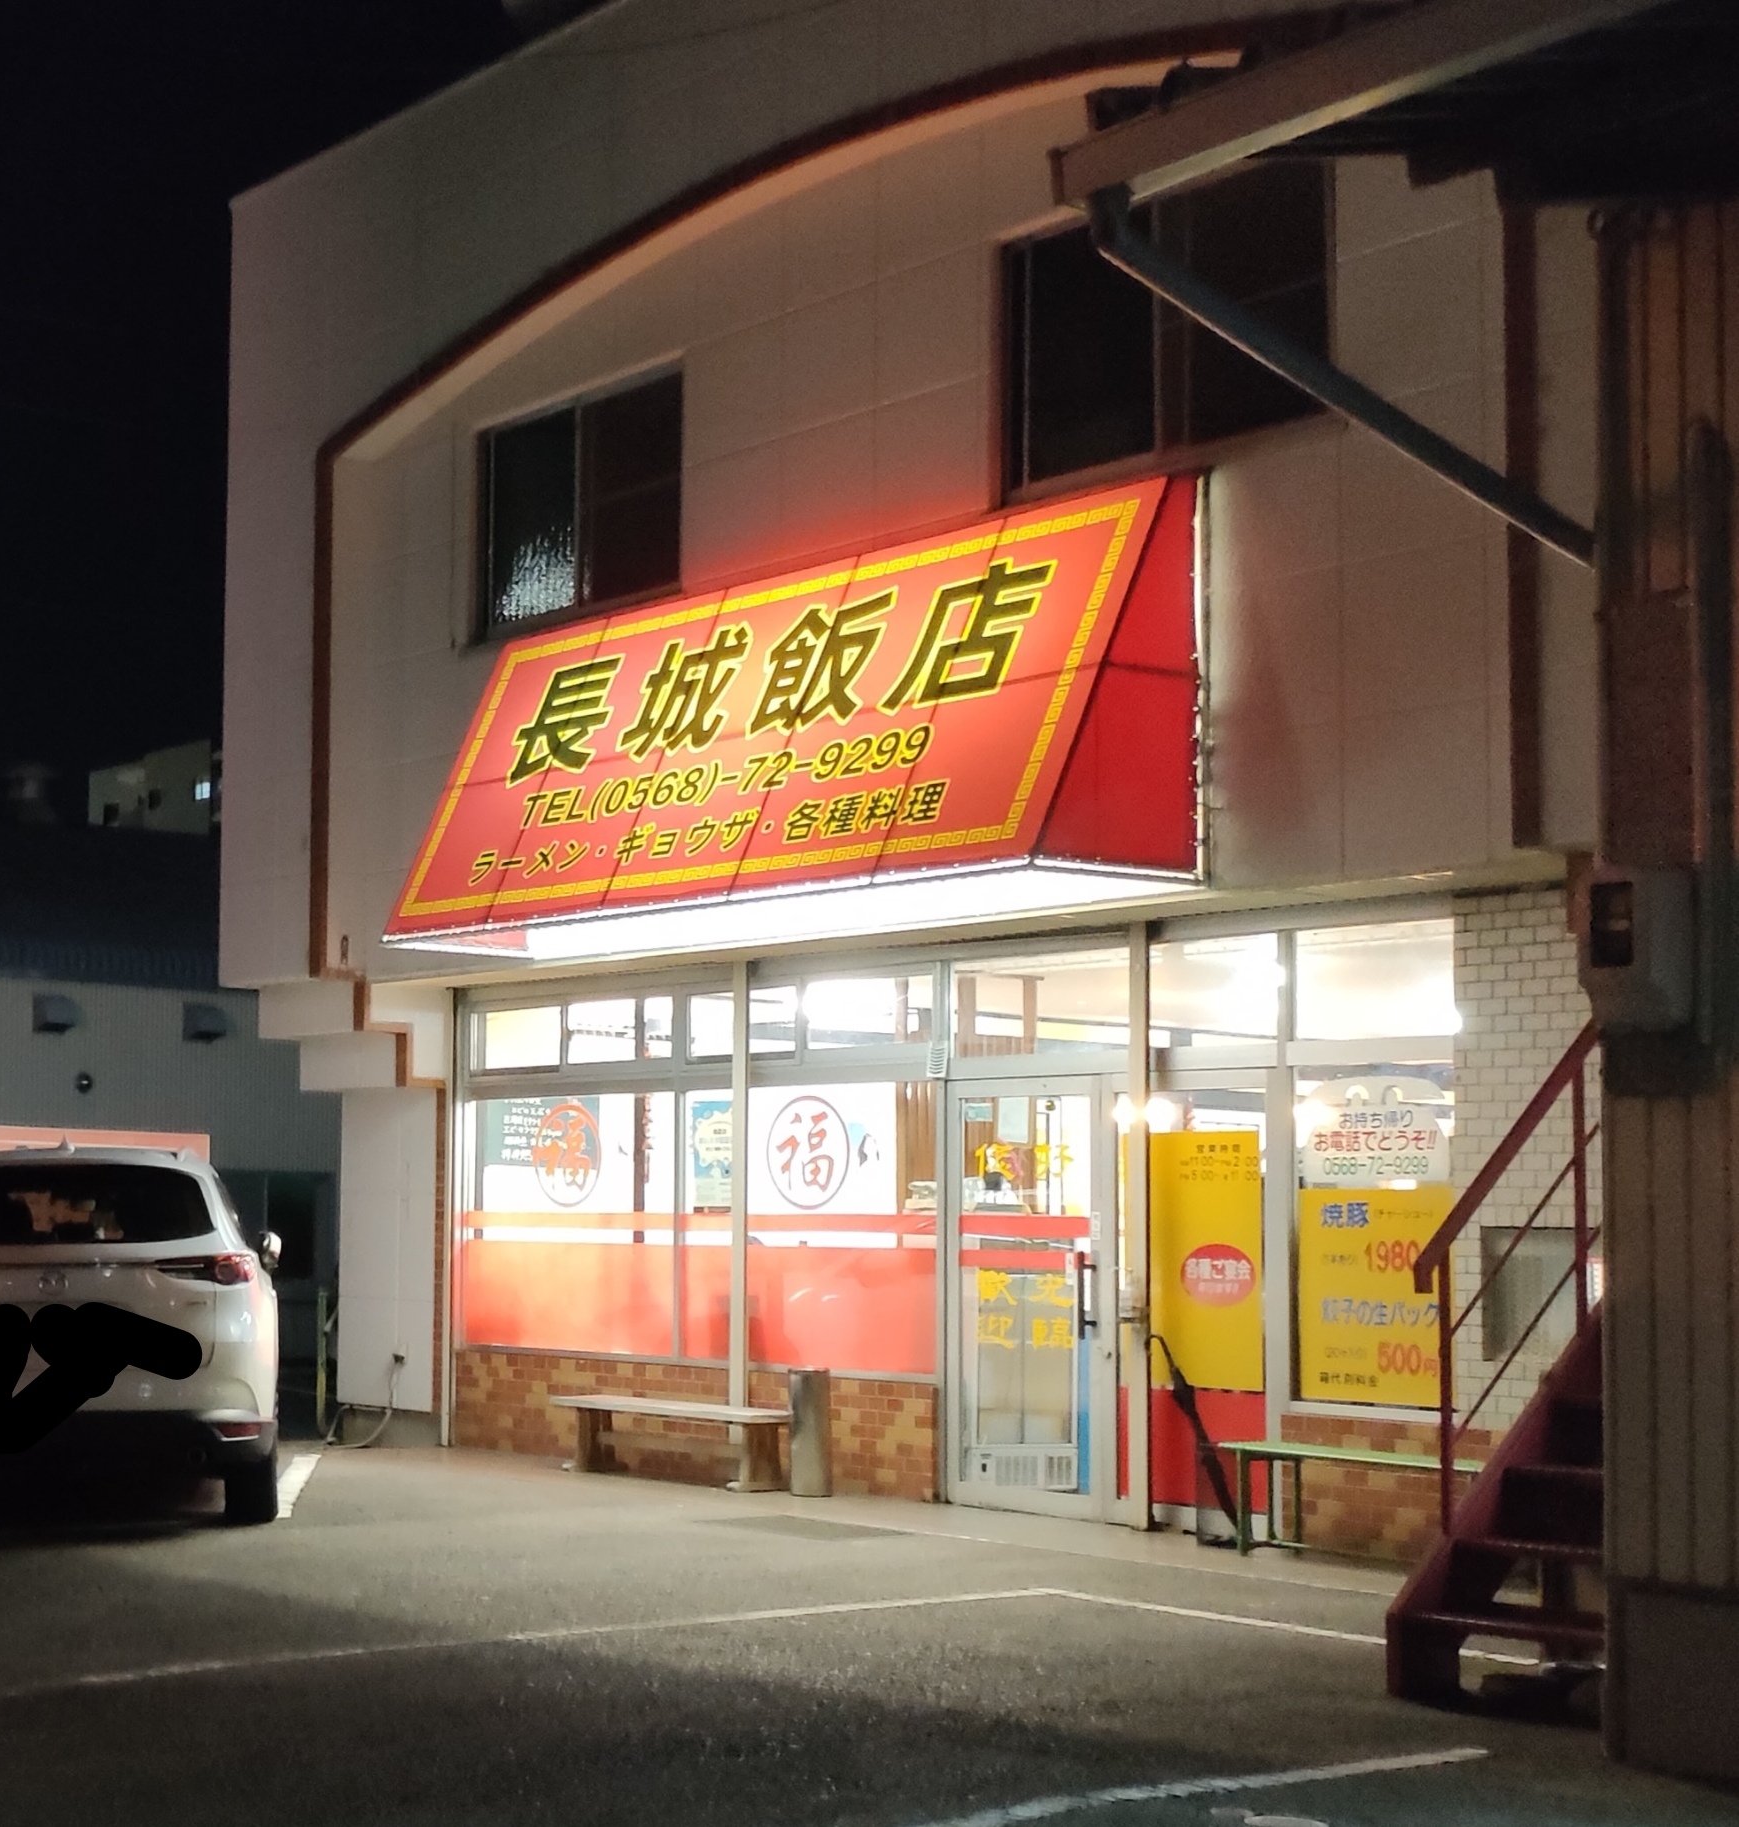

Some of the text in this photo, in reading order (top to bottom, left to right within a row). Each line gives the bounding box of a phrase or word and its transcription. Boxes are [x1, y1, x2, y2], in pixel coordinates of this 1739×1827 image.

[506, 557, 1059, 786] 長城飯店
[521, 725, 933, 831] TEL(0568)-72-9299
[1339, 1110, 1414, 1130] お持ち帰り
[776, 1110, 835, 1194] 福
[1322, 1156, 1430, 1176] 0568-72-9299
[1321, 1201, 1370, 1229] 焼豚
[1364, 1239, 1421, 1274] 1980
